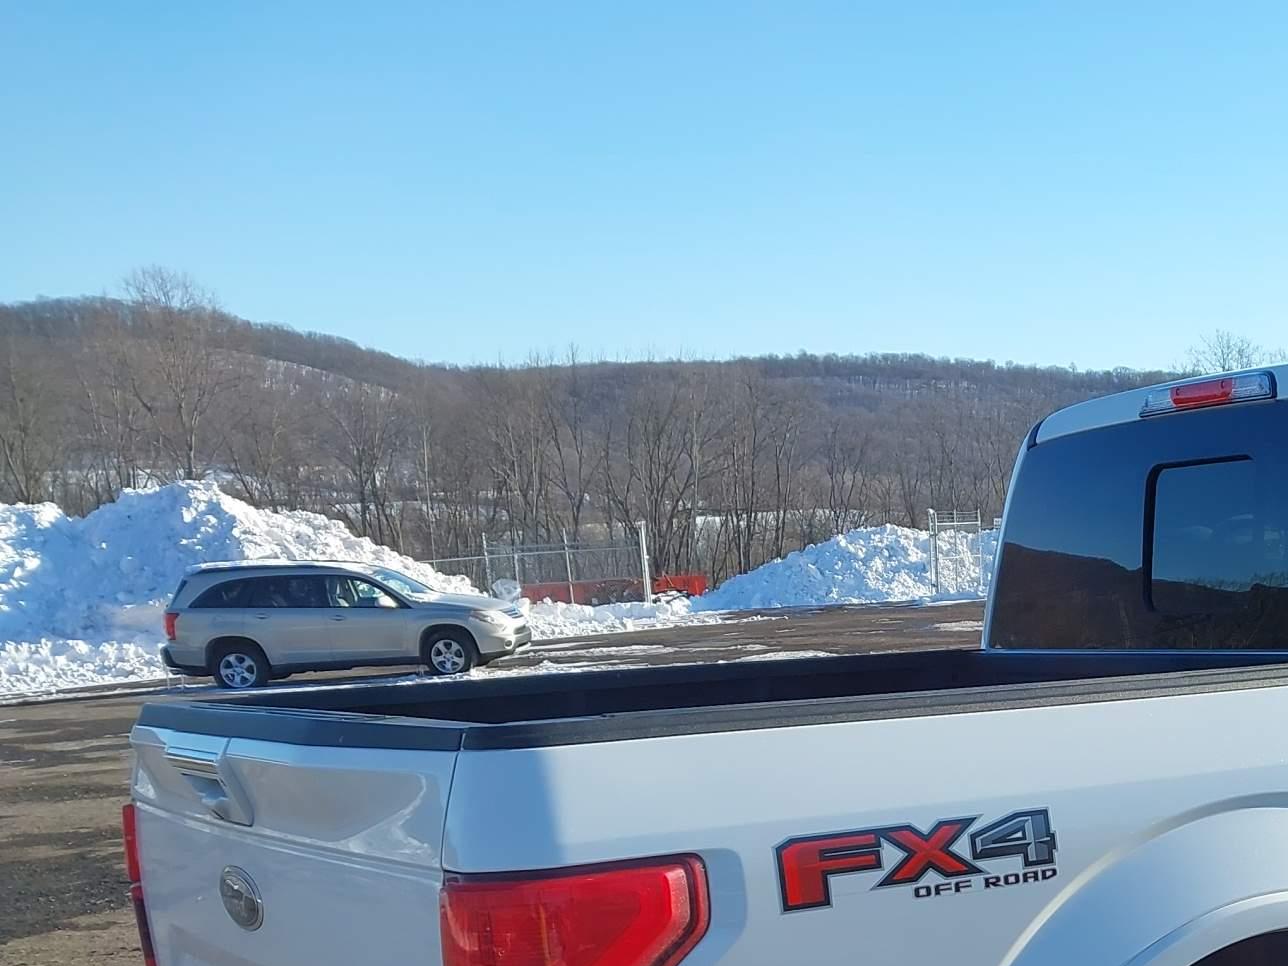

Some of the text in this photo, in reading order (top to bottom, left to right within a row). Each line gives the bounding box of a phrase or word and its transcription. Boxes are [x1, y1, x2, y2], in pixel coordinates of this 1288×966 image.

[774, 807, 1057, 912] FX4
[914, 868, 1057, 898] OFF ROAD
